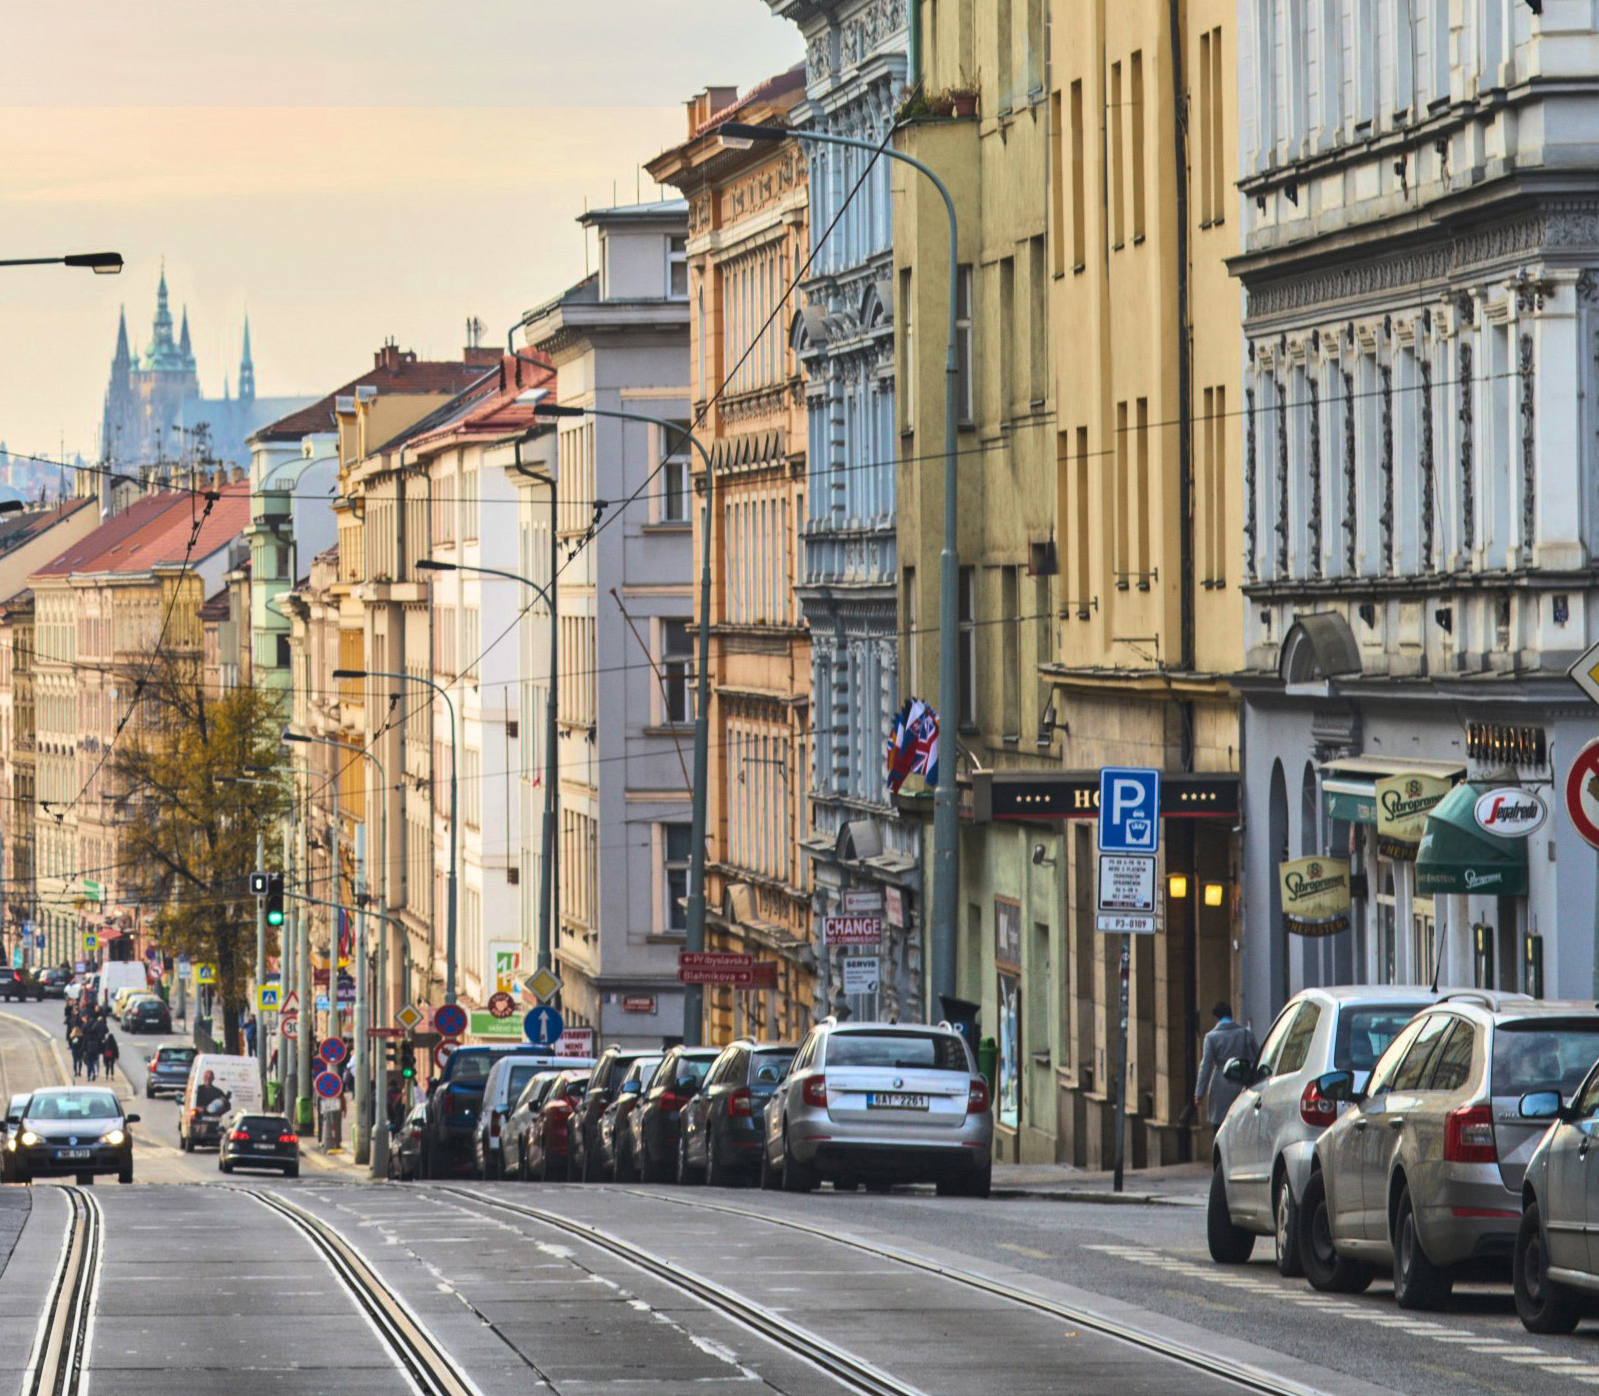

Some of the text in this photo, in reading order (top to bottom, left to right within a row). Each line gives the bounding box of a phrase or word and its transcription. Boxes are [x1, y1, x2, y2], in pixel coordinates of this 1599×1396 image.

[1112, 778, 1146, 825] P
[1484, 797, 1538, 825] Segafredo
[1284, 871, 1347, 902] Staropramen
[826, 918, 880, 935] CHANGE
